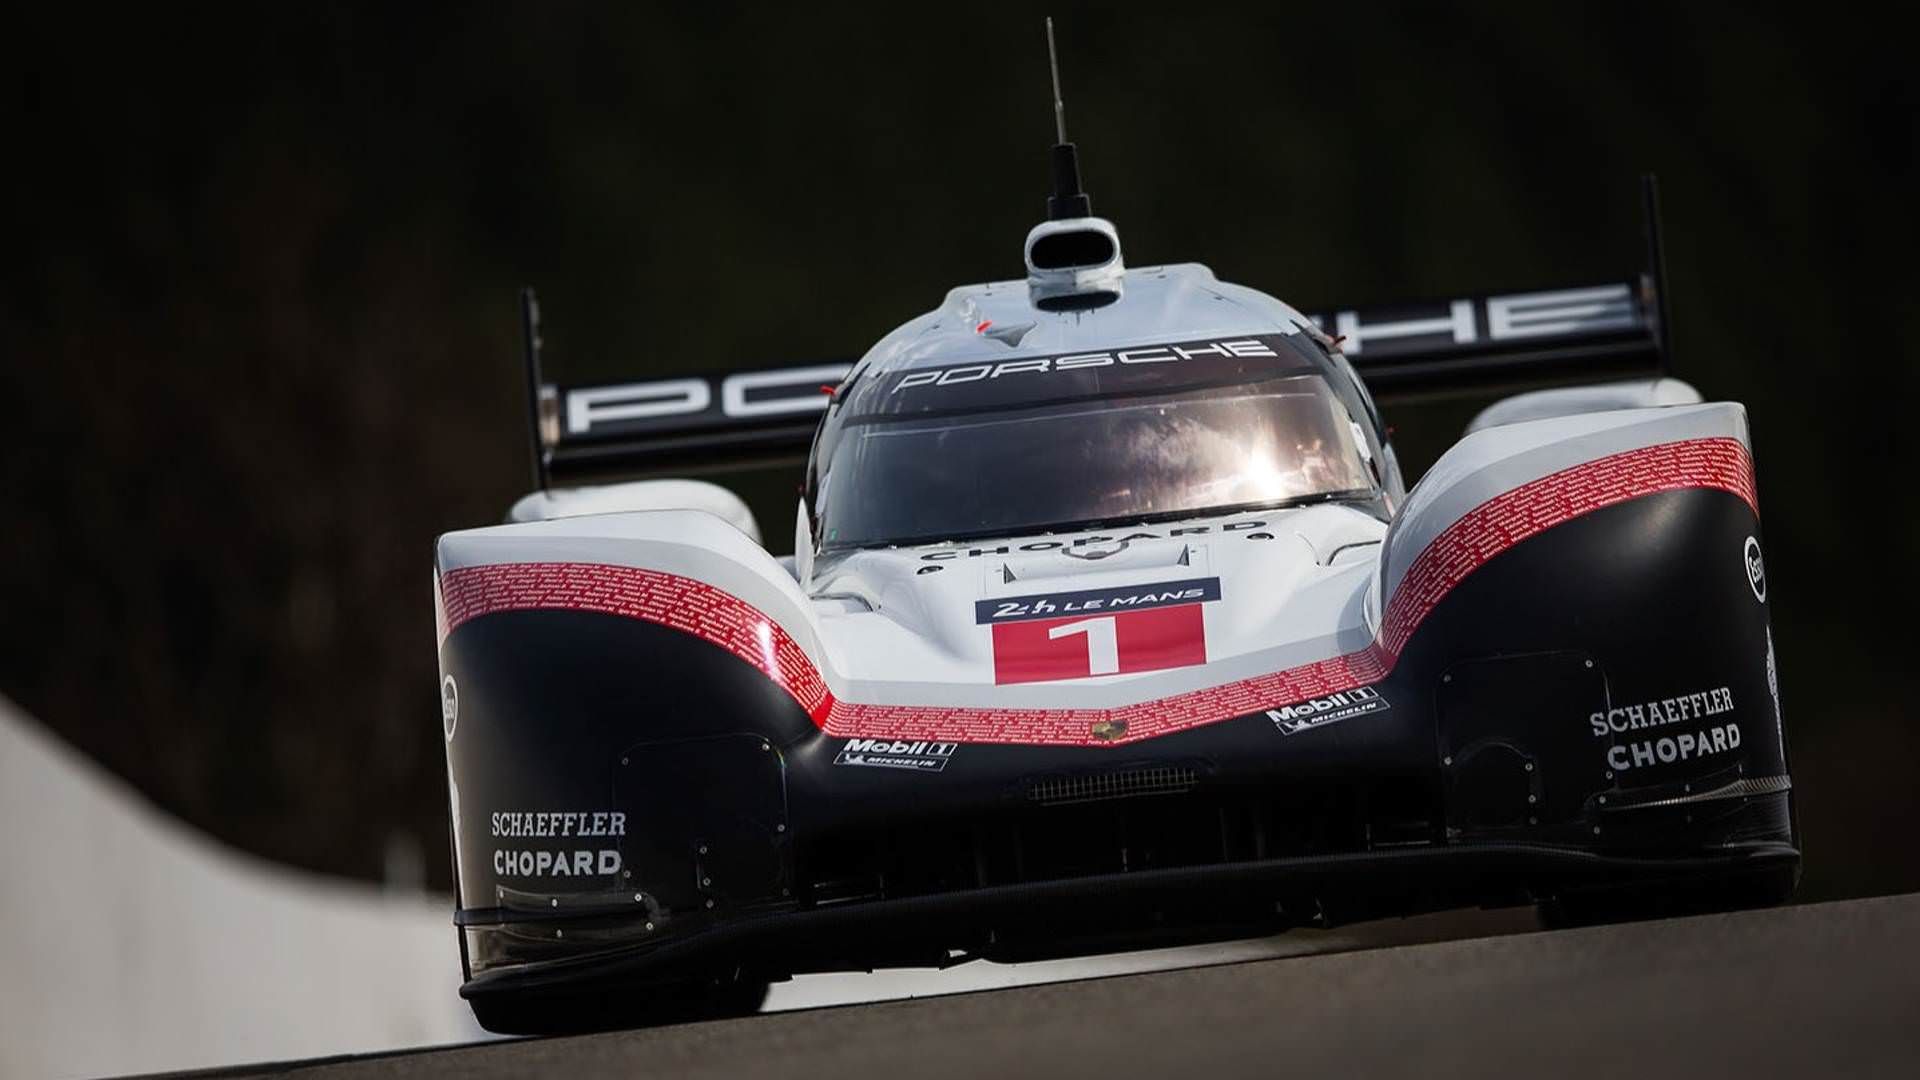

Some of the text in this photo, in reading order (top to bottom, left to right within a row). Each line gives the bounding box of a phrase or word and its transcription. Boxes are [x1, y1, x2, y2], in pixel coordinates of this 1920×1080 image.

[891, 339, 1277, 394] PORSCHE
[920, 521, 1267, 560] CHOPARD
[1064, 599, 1103, 611] LE
[1110, 588, 1203, 607] MANS
[1048, 616, 1120, 676] 1
[1266, 693, 1349, 722] Mobil
[1311, 702, 1377, 724] MICHELIN
[1590, 687, 1734, 736] SCHAEFFLER
[844, 739, 927, 754] Mobil
[1607, 723, 1740, 770] CHOPARD
[866, 757, 936, 767] MICHELIN
[492, 811, 626, 837] SCHAEFFLER
[494, 850, 622, 876] CHOPARD
